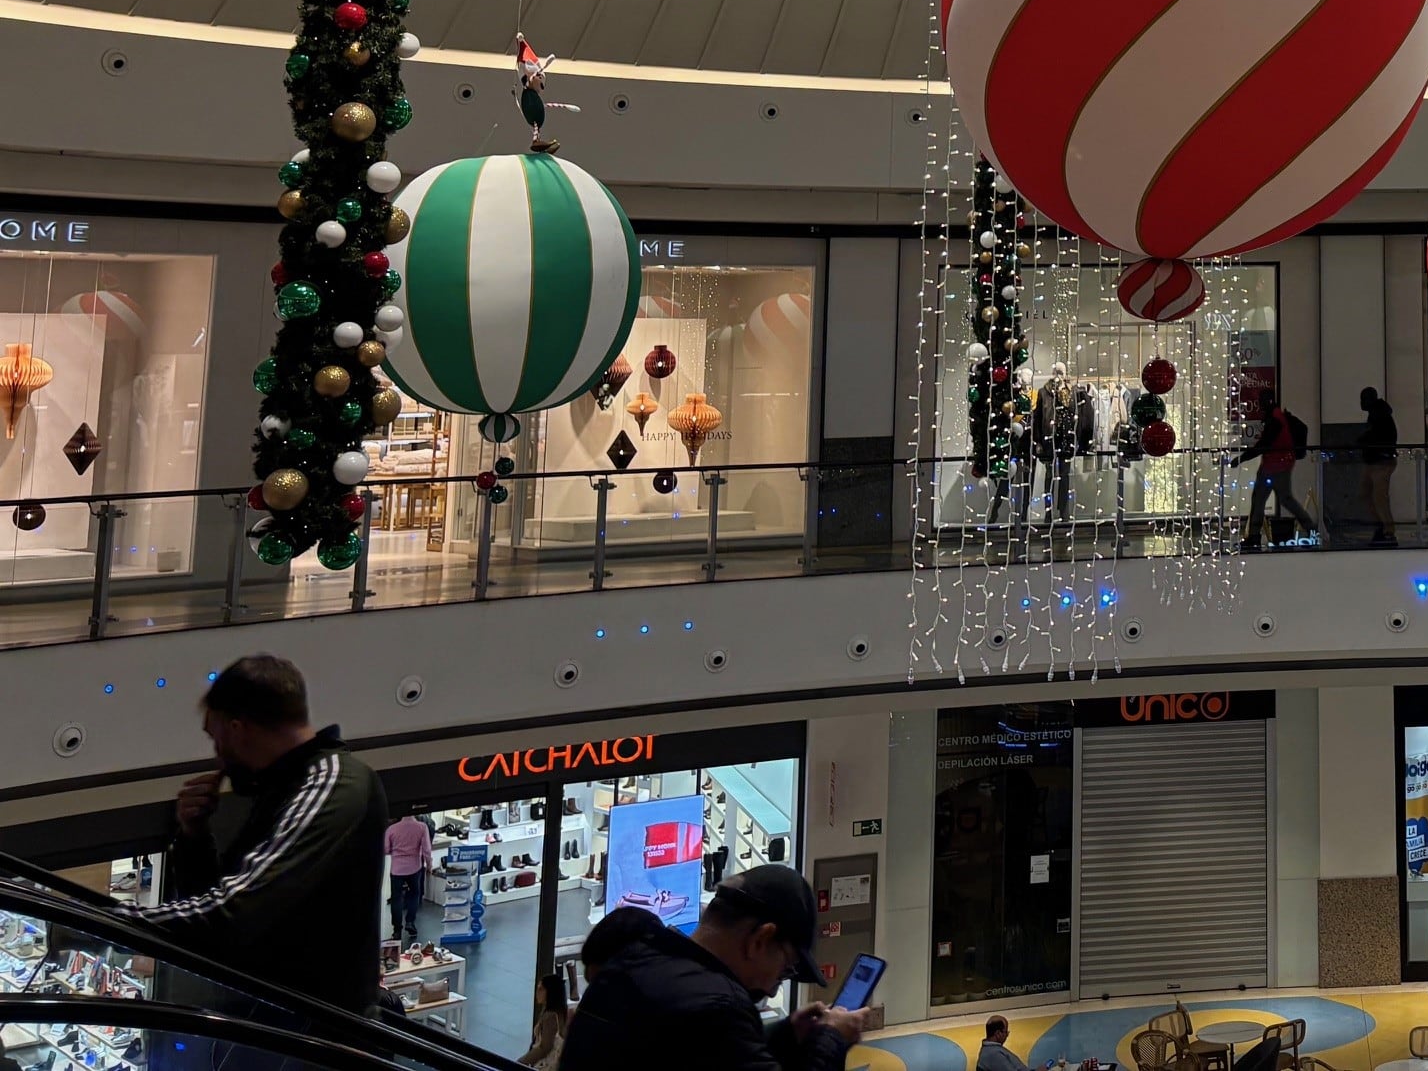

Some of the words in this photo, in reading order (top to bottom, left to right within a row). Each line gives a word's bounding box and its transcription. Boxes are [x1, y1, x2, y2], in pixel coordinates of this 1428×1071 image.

[642, 432, 666, 442] HAPPY
[938, 736, 980, 747] CENTRO
[982, 732, 1021, 744] MÉDICO
[1023, 729, 1072, 741] ESTÉTICO
[938, 755, 998, 769] DEPILACIÓN
[1000, 753, 1034, 765] LÁSER
[1408, 827, 1416, 835] LA
[985, 980, 1067, 997] centrosunico.com
